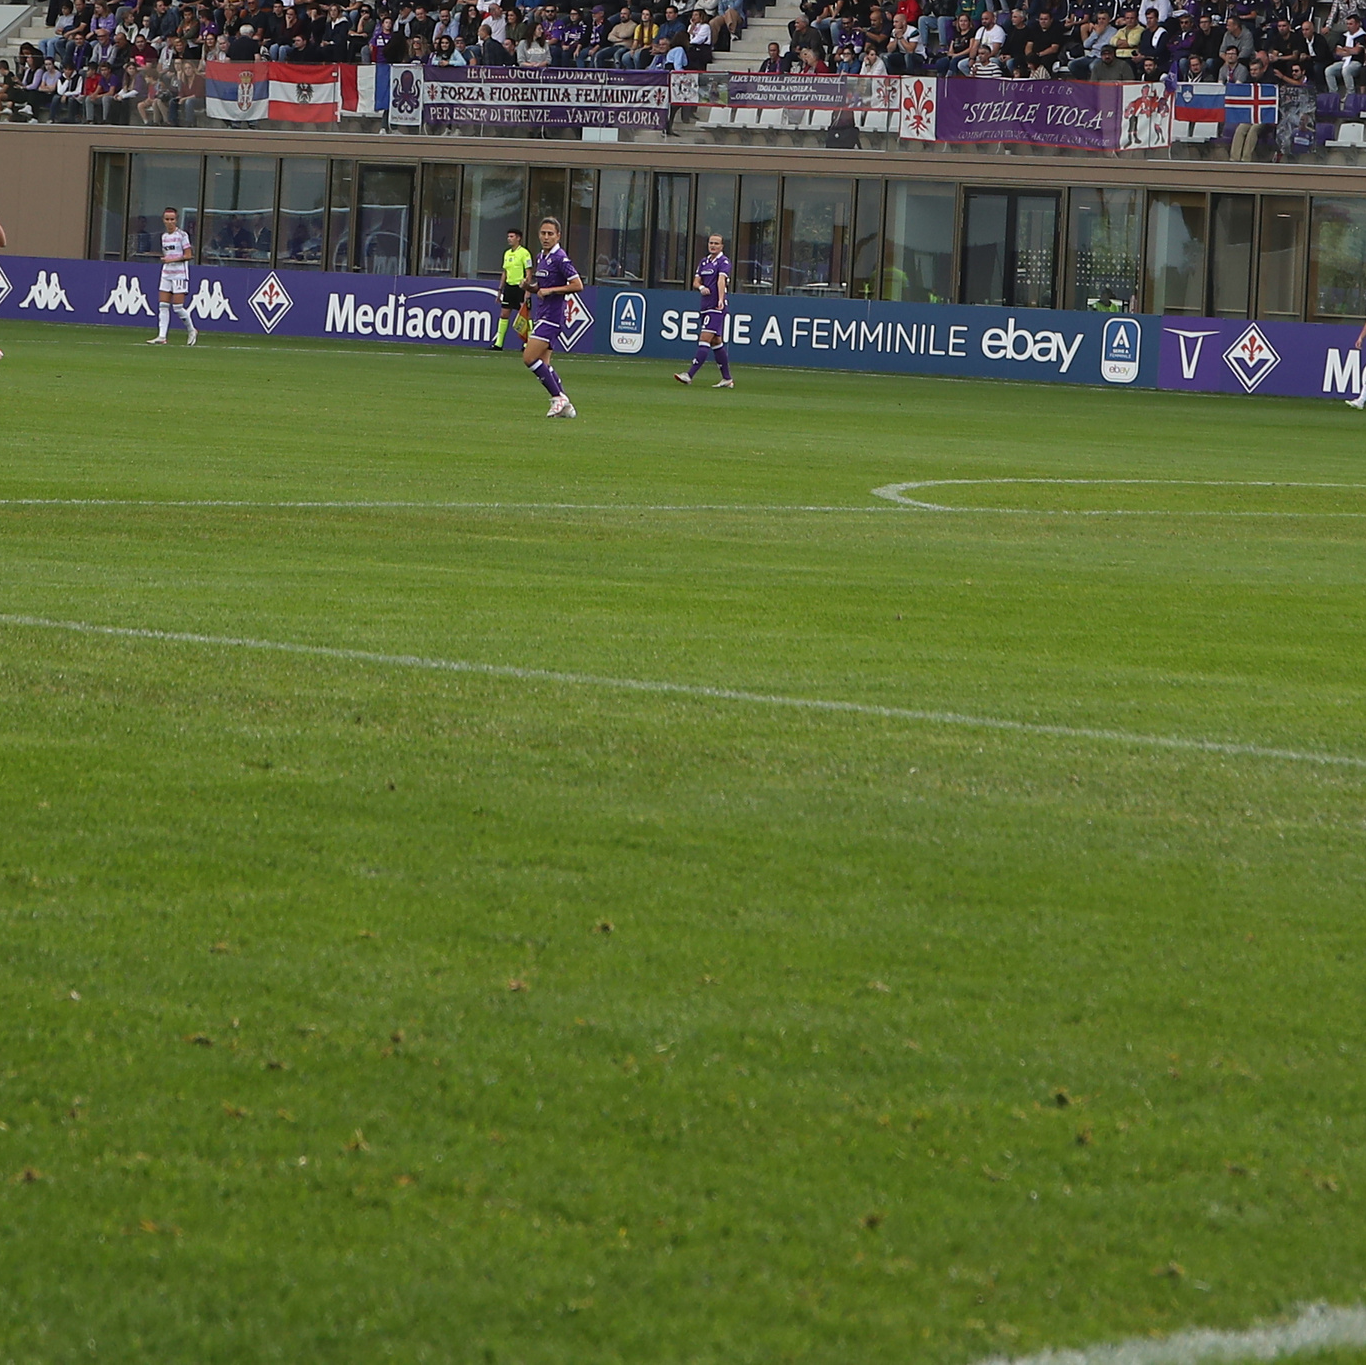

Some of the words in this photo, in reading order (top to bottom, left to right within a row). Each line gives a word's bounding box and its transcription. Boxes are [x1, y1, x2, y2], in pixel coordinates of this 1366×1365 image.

[440, 85, 485, 102] FORZA
[490, 86, 572, 103] FIORENTINA
[575, 88, 652, 105] FEMMINILE
[1041, 85, 1073, 95] CLUB
[430, 106, 451, 121] PER
[453, 106, 488, 122] ESSER
[490, 108, 501, 122] DI
[608, 110, 615, 124] E
[617, 110, 660, 126] GLORIA
[962, 100, 1041, 124] "STELLE
[1046, 104, 1114, 131] VIOLA"
[325, 293, 492, 342] Mediacom
[660, 310, 752, 345] SEIE
[760, 315, 783, 346] A
[791, 317, 969, 357] FEMMINILE
[981, 318, 1085, 374] ebay
[1109, 364, 1130, 376] ebay
